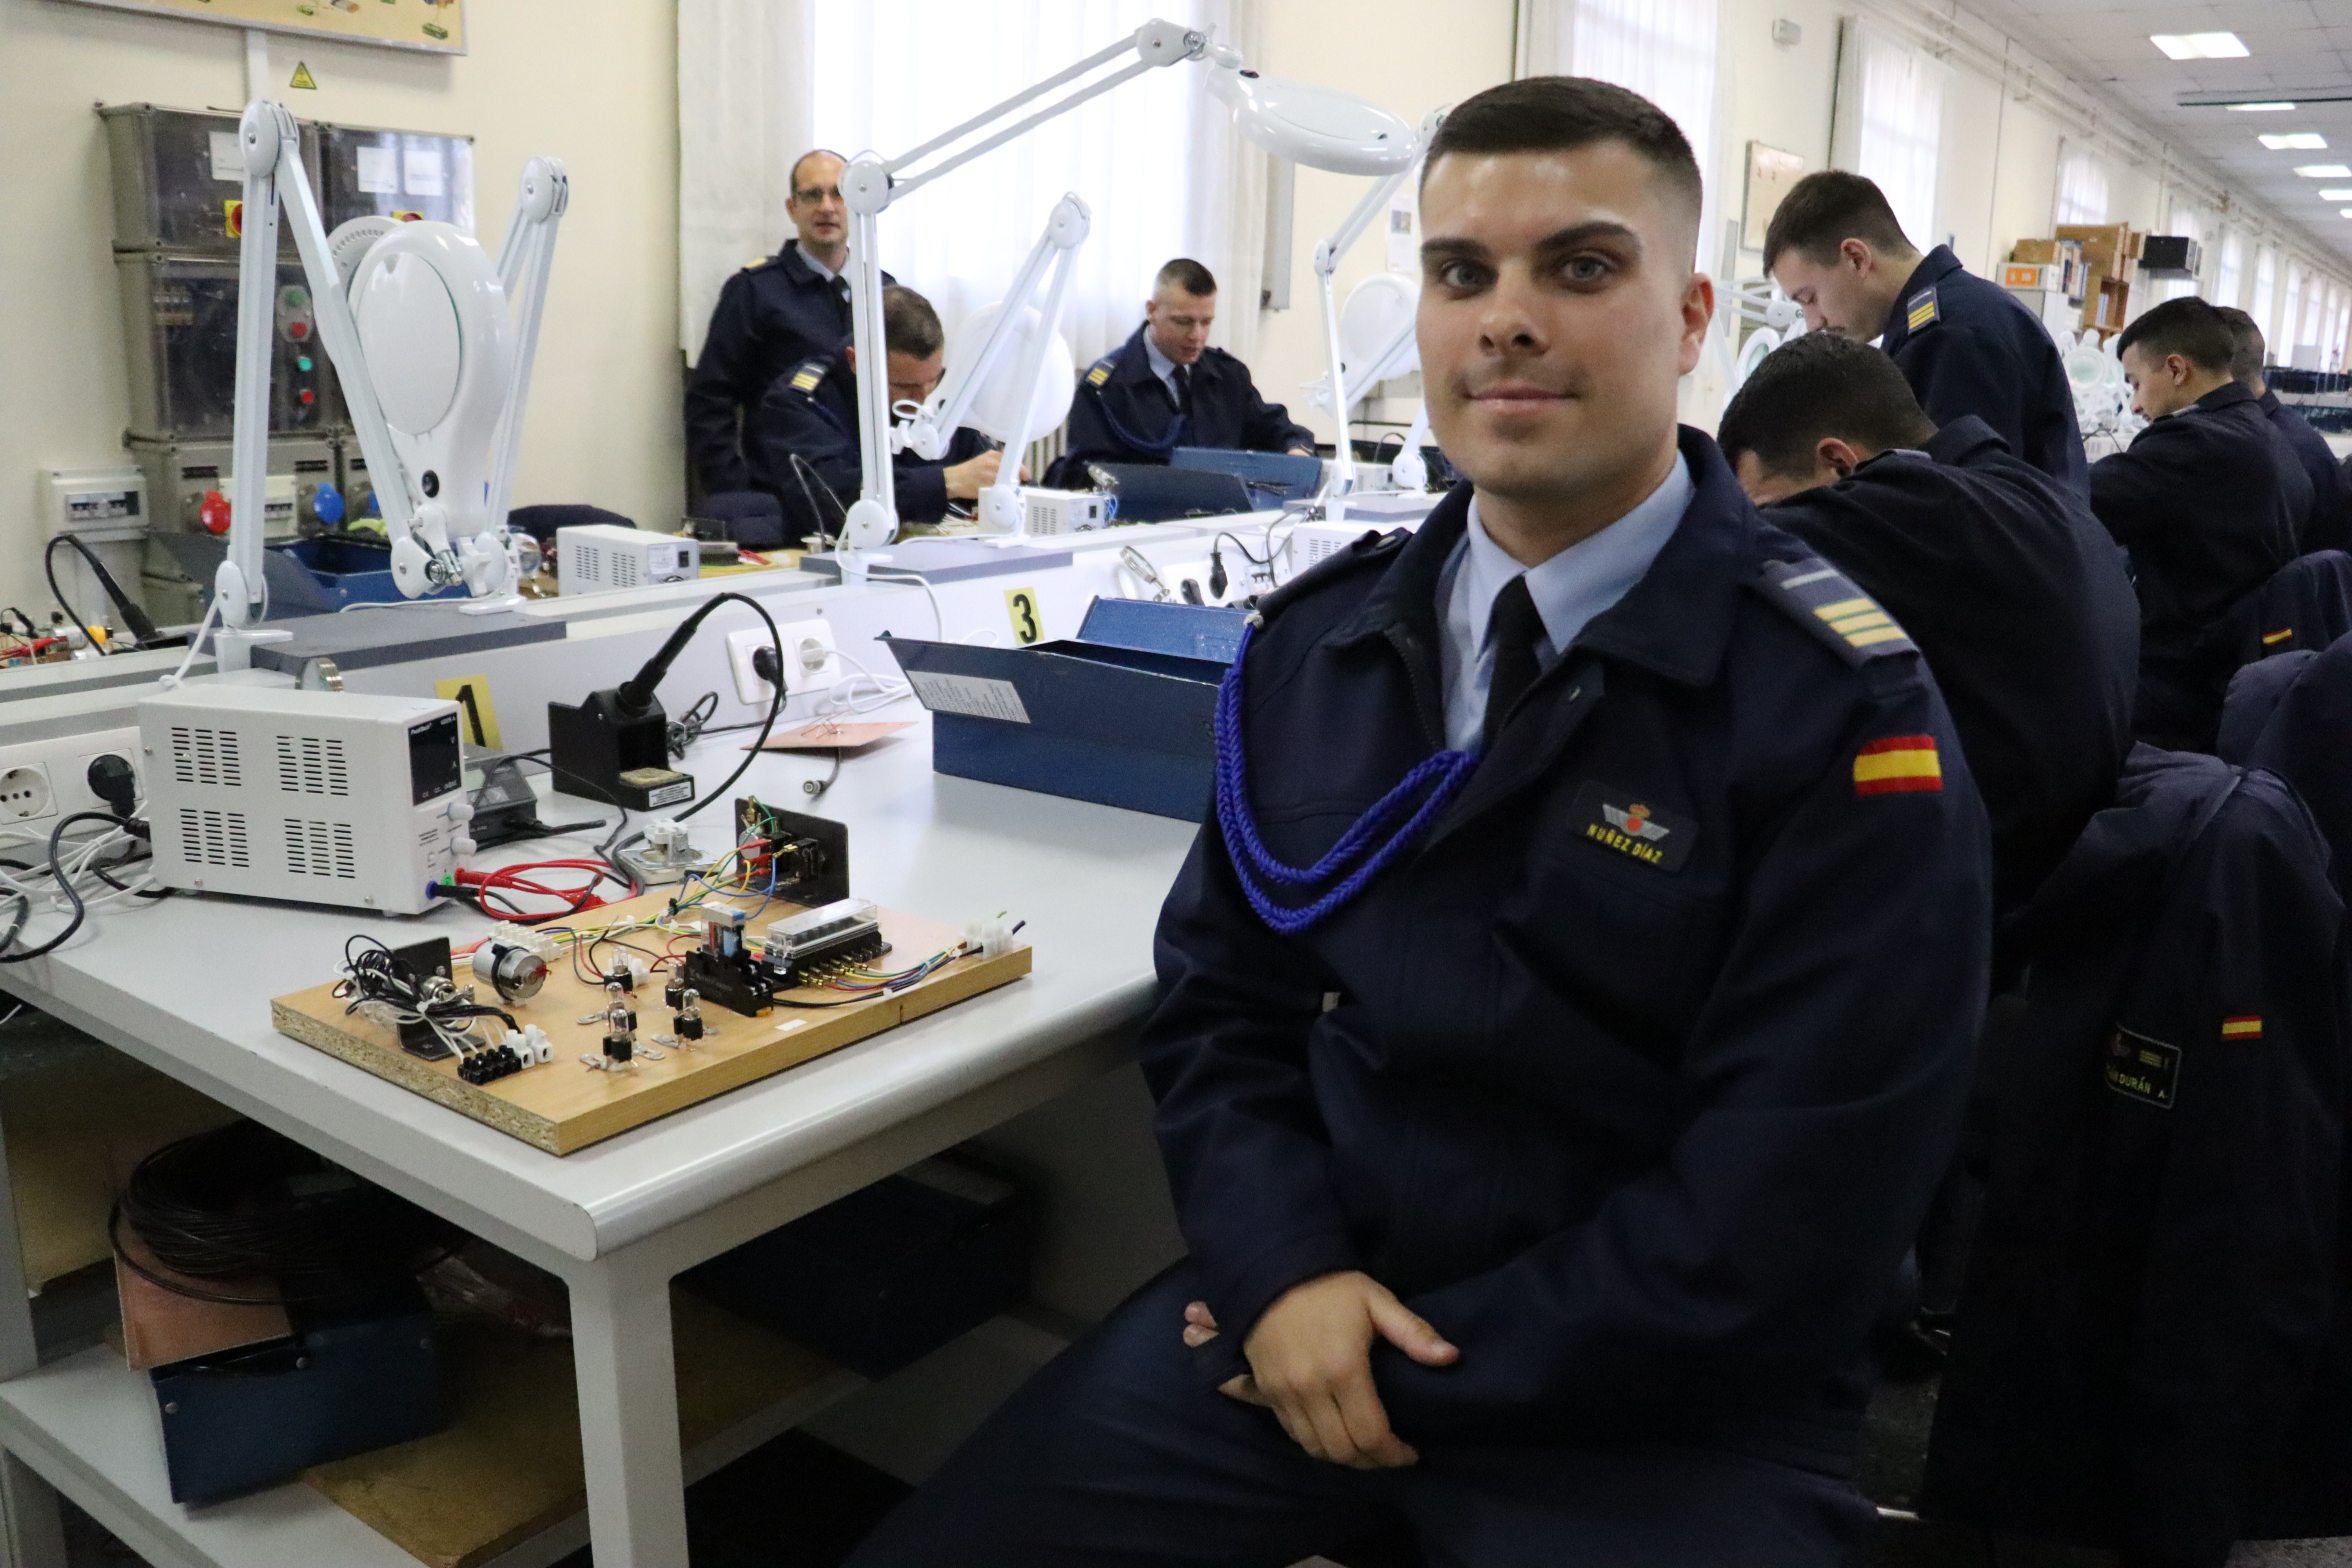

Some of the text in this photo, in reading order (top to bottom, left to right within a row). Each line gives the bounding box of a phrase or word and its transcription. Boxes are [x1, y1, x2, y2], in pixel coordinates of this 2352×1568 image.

[1013, 593, 1037, 644] 3
[455, 684, 486, 747] 1
[451, 735, 455, 744] V
[1587, 824, 1663, 864] NUÑEZ DÍAZ
